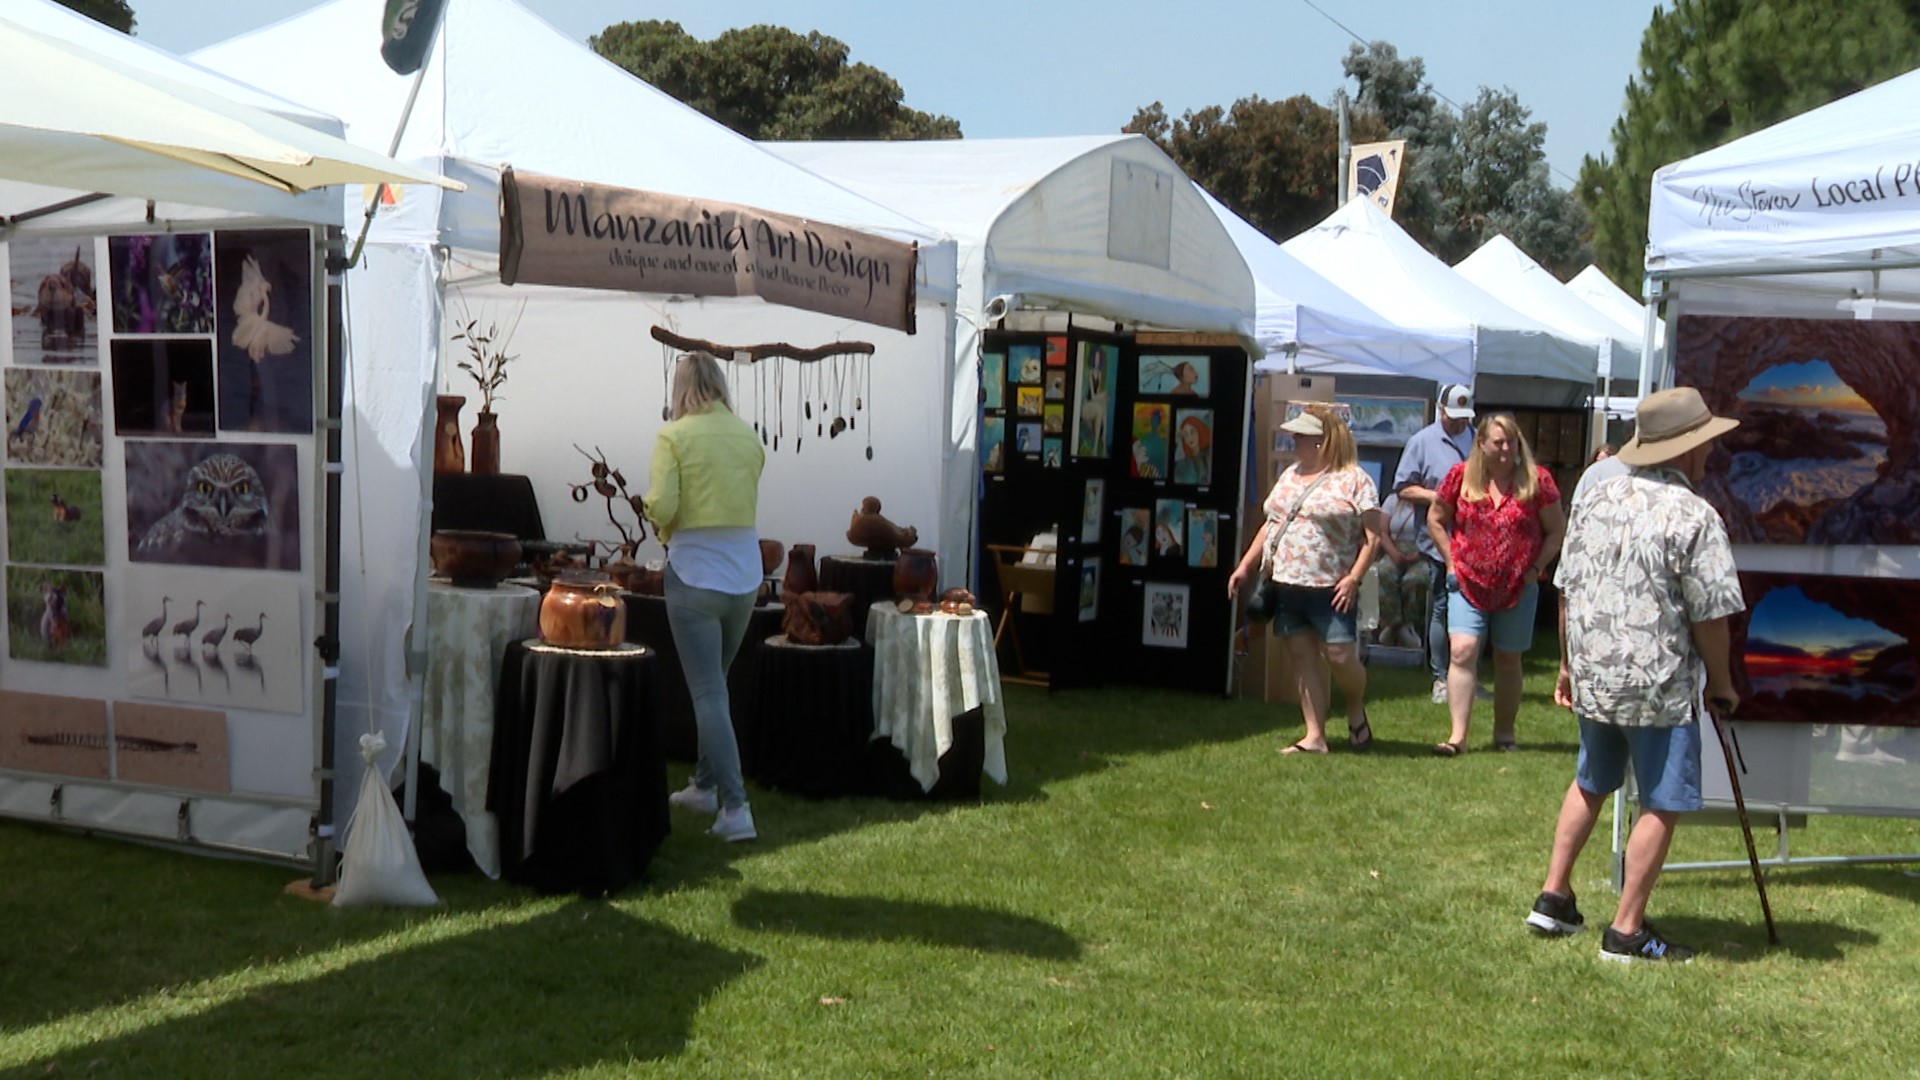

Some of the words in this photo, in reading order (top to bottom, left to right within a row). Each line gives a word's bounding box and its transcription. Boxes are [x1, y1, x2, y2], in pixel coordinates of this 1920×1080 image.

[1812, 166, 1886, 207] Local
[545, 189, 749, 251] Manzanita
[757, 219, 797, 263] Art
[803, 230, 890, 308] Design
[609, 248, 659, 279] Unique
[663, 254, 692, 272] and
[695, 260, 720, 273] one
[724, 253, 738, 273] of
[781, 266, 816, 289] Home
[819, 275, 849, 297] Decor
[1642, 939, 1666, 957] N
